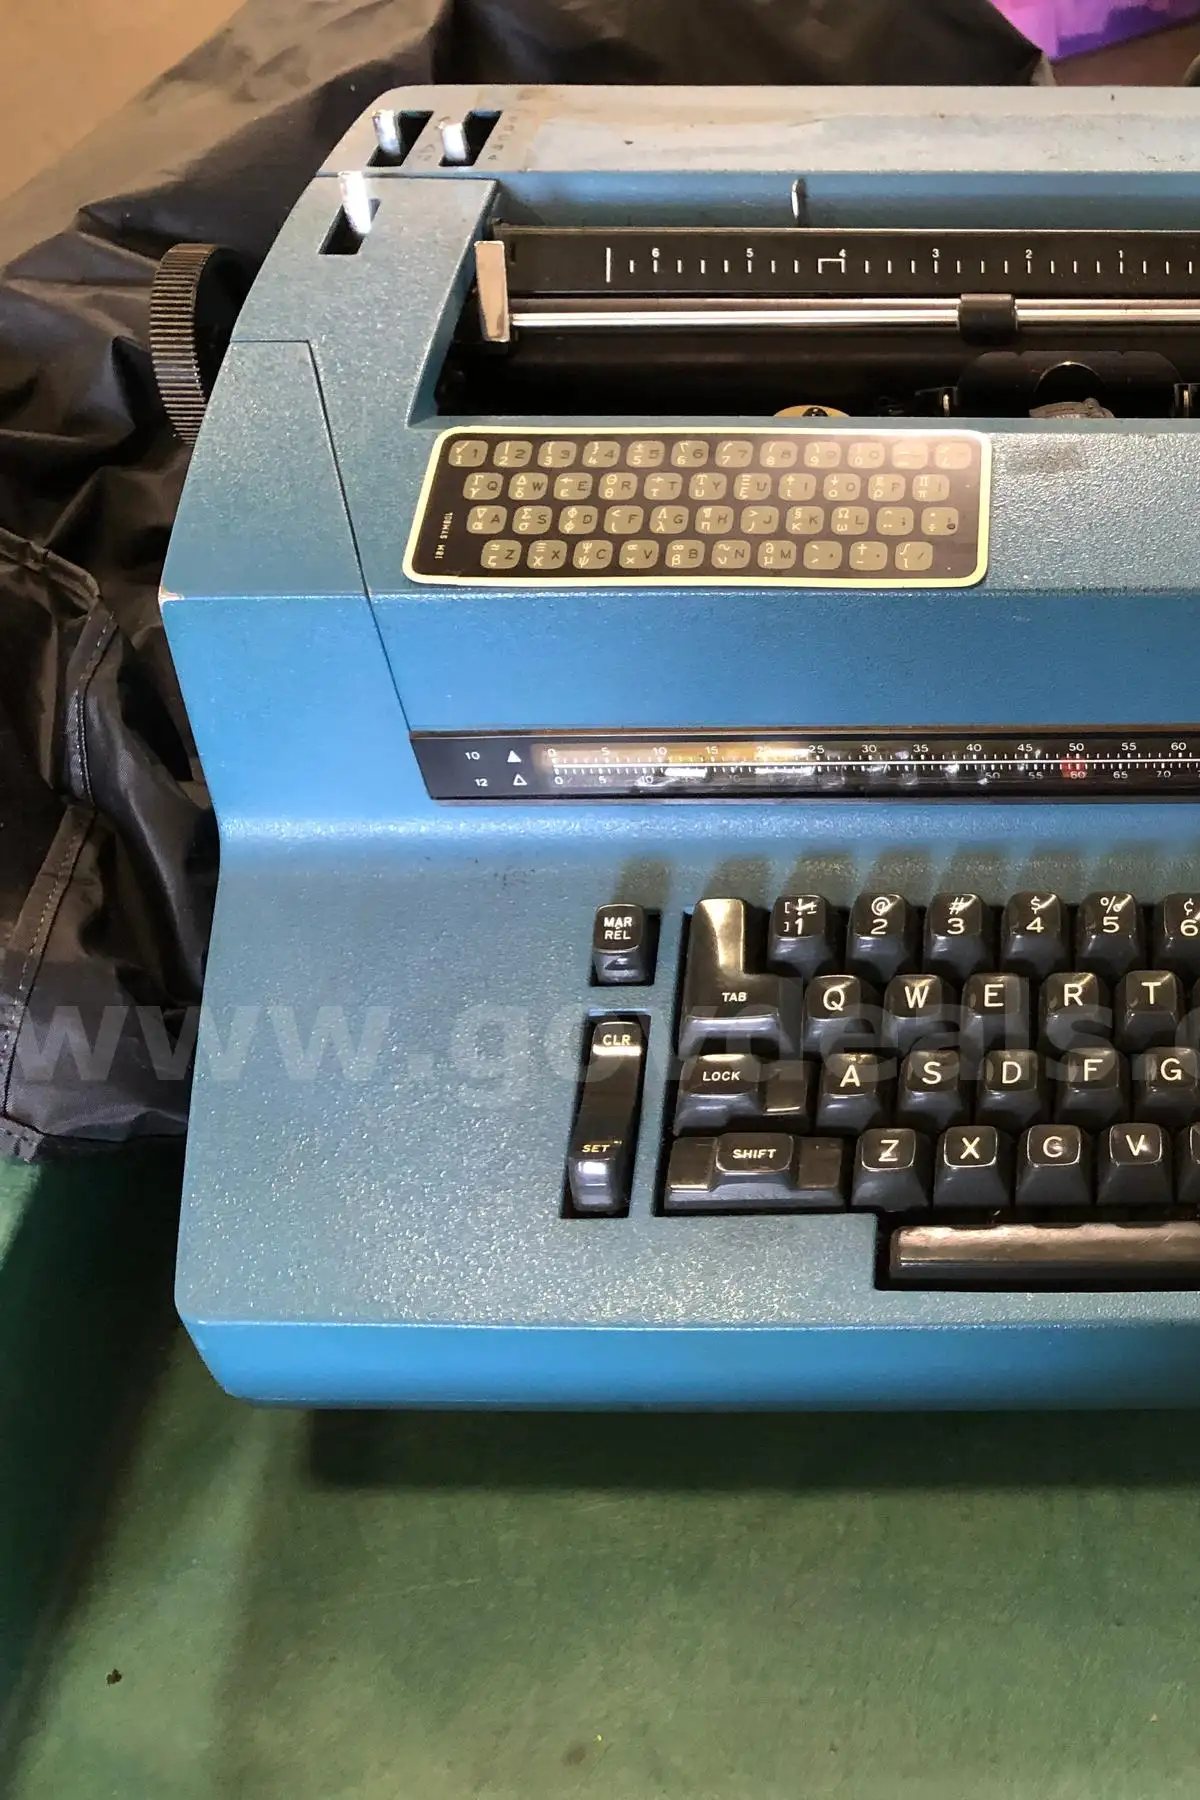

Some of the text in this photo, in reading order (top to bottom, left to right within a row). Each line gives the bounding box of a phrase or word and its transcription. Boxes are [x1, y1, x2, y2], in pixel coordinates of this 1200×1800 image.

[652, 248, 660, 258] 6
[747, 248, 753, 258] 5
[839, 249, 846, 257] 4
[932, 249, 939, 258] 3
[1026, 249, 1032, 259] 2
[1119, 249, 1124, 259] 1
[434, 545, 446, 560] IBM
[601, 747, 610, 756] 5
[653, 747, 667, 756] 10
[808, 745, 825, 754] 25
[861, 744, 877, 753] 30
[913, 744, 928, 753] 35
[966, 743, 982, 752] 40
[1017, 743, 1033, 752] 45
[1069, 742, 1085, 751] 50
[1121, 742, 1137, 751] 55
[1171, 741, 1187, 751] 60
[465, 751, 480, 761] 10
[474, 778, 488, 787] 12
[554, 776, 563, 785] 0
[599, 776, 607, 785] 5
[1028, 771, 1044, 780] 55
[1070, 770, 1086, 780] 60
[1113, 770, 1129, 779] 65
[1156, 770, 1172, 779] 70
[604, 917, 633, 927] MAR
[870, 918, 888, 935] 2
[947, 918, 966, 935] 3
[1026, 917, 1045, 934] 4
[1102, 916, 1120, 934] 5
[1180, 919, 1199, 937] 6
[604, 929, 632, 940] REL
[722, 991, 748, 1003] TAB
[823, 986, 846, 1012] Q
[904, 985, 929, 1009] W
[984, 984, 1005, 1008] E
[1063, 983, 1084, 1007] R
[1141, 981, 1162, 1005] T
[602, 1034, 632, 1046] CLR
[702, 1071, 741, 1082] LOCK
[840, 1064, 861, 1088] A
[922, 1061, 943, 1085] S
[1001, 1060, 1022, 1085] D
[1083, 1058, 1103, 1082] F
[1160, 1057, 1182, 1082] G
[581, 1143, 611, 1154] SET
[732, 1148, 777, 1160] SHIFT
[878, 1139, 900, 1162] Z
[960, 1136, 981, 1160] X
[1125, 1134, 1146, 1157] V
